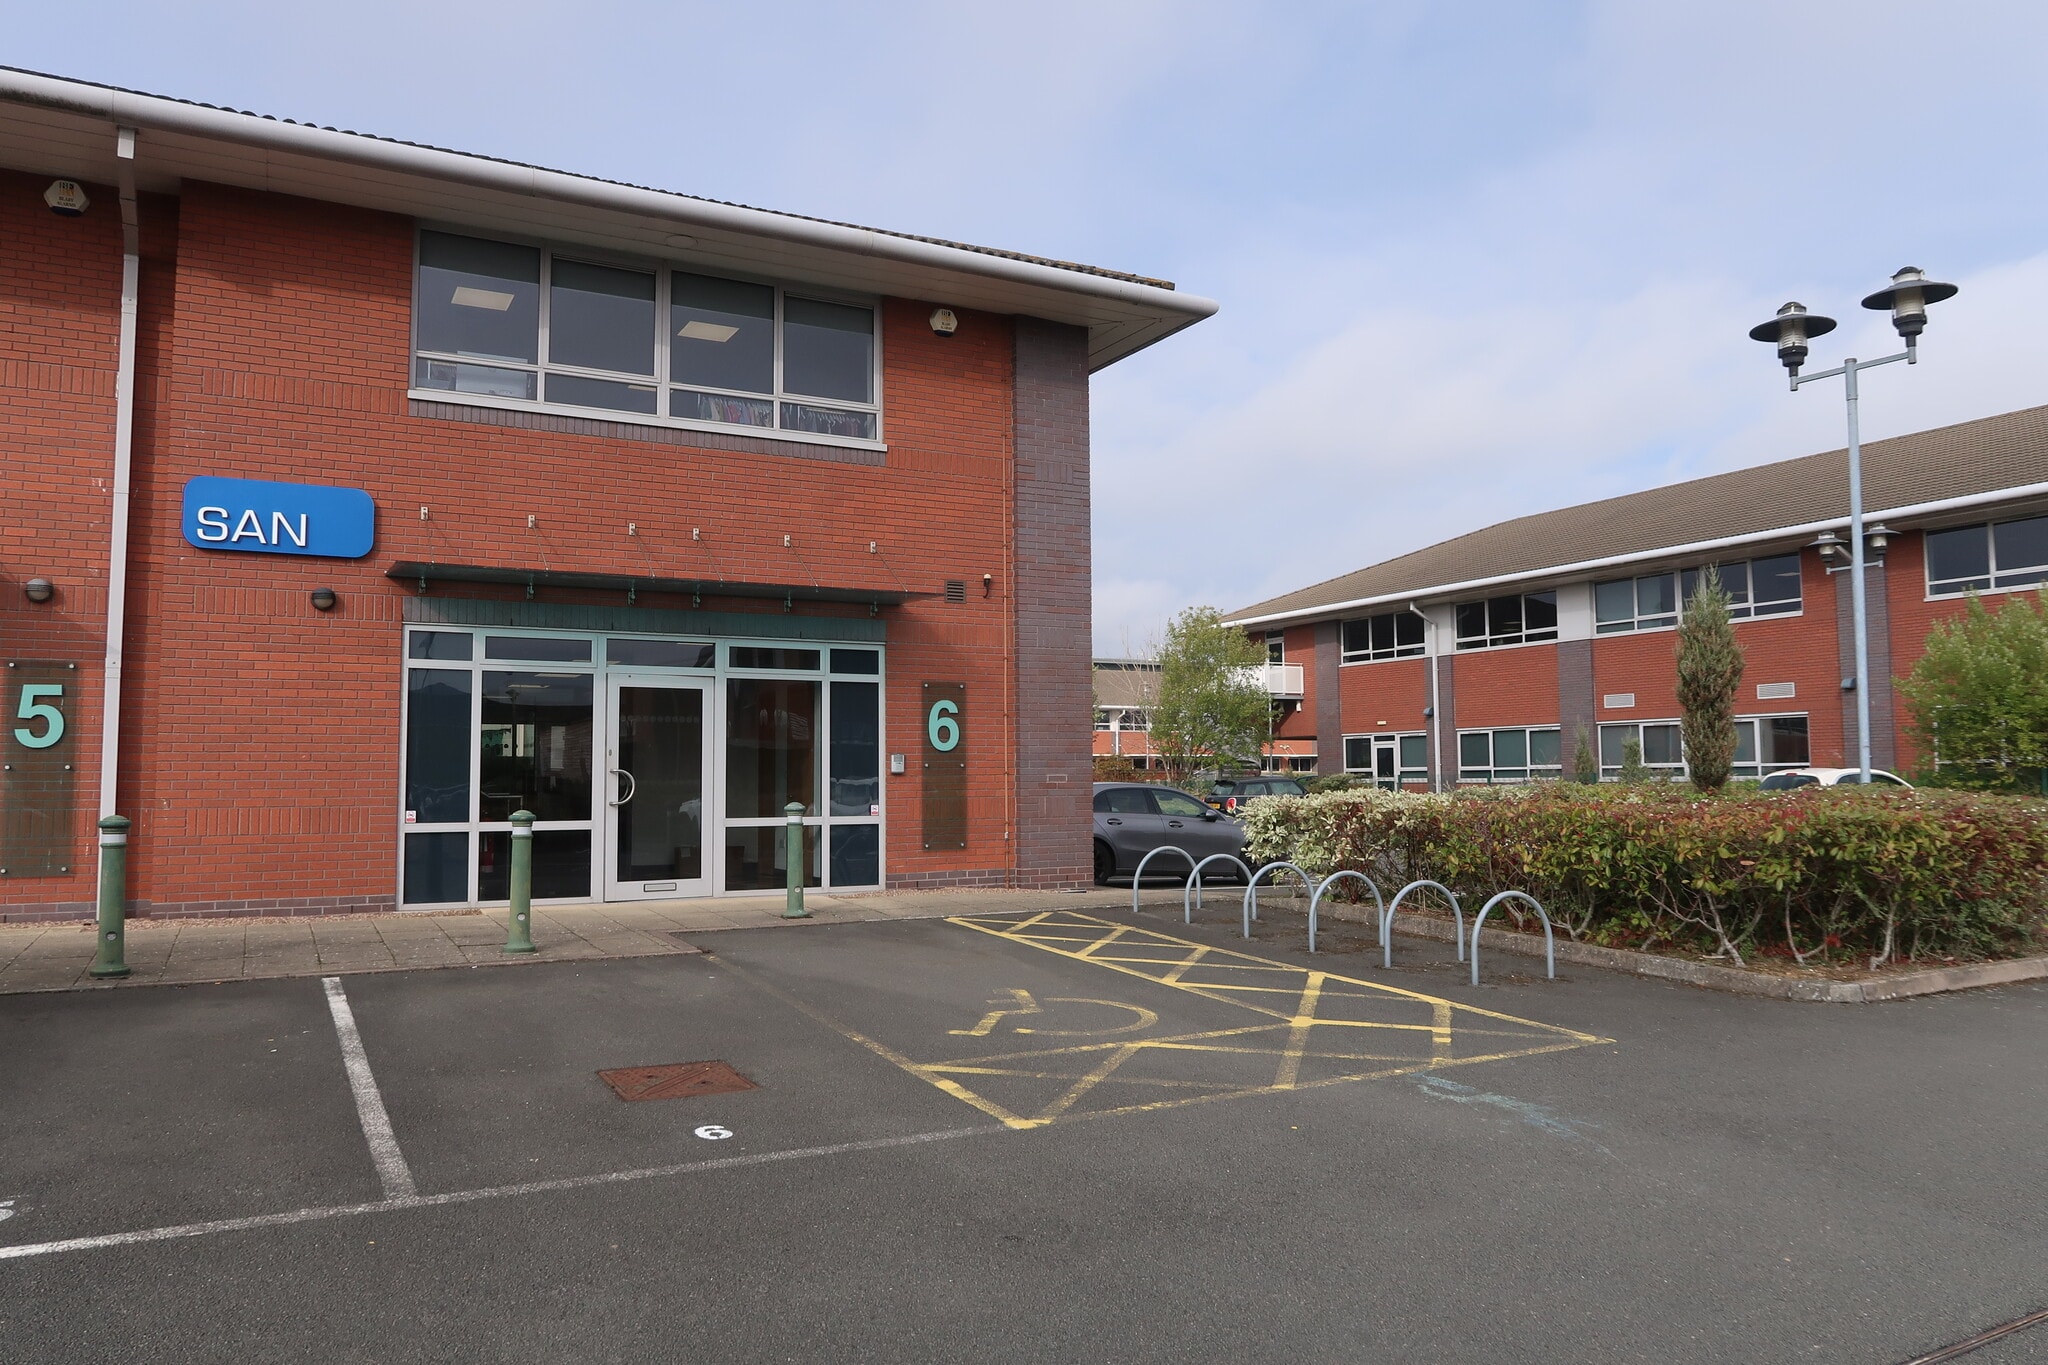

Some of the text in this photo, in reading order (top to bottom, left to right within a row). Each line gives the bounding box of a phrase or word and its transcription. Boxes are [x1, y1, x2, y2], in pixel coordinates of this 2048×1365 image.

[197, 506, 307, 547] SAN
[14, 684, 65, 748] 5
[929, 699, 960, 752] 6
[694, 1124, 733, 1140] 6
